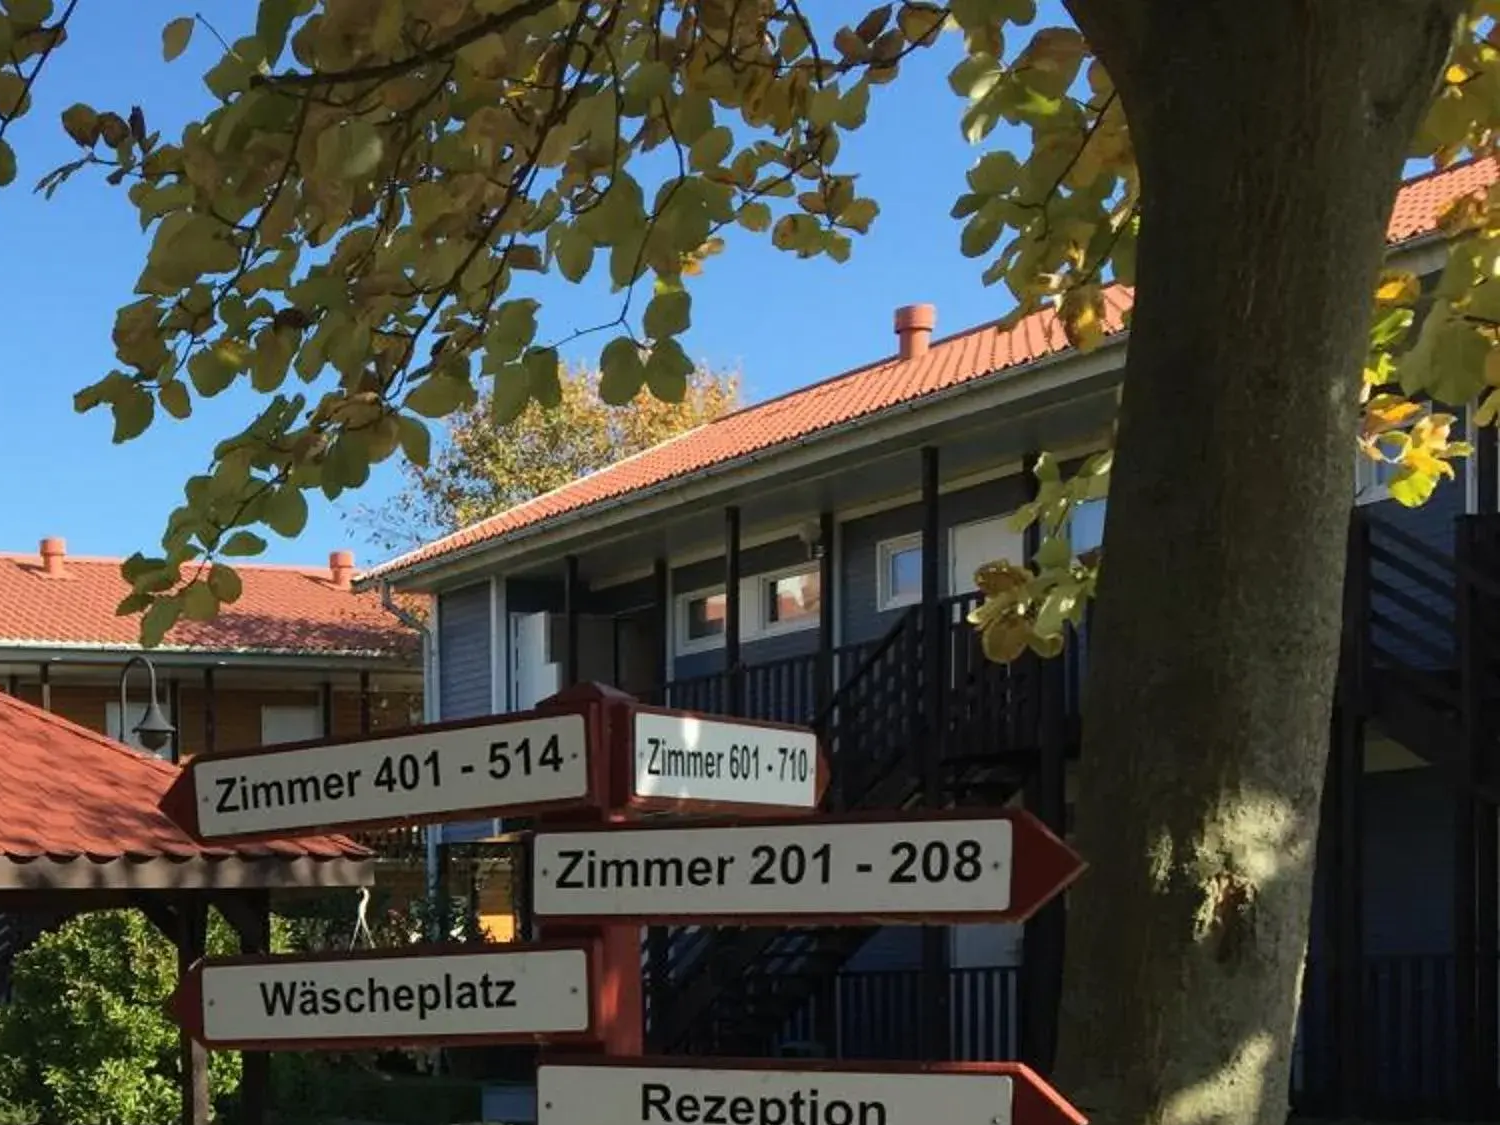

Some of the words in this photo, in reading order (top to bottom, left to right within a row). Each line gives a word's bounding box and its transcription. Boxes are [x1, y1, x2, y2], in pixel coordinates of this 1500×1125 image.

[215, 769, 361, 814] Zimmer
[373, 750, 441, 793] 401
[489, 734, 564, 780] 514
[647, 737, 725, 779] Zimmer
[729, 744, 759, 780] 601
[778, 747, 807, 782] 710
[555, 849, 735, 889] Zimmer
[750, 843, 831, 885] 201
[889, 839, 982, 884] 208
[259, 973, 517, 1020] Wäscheplatz
